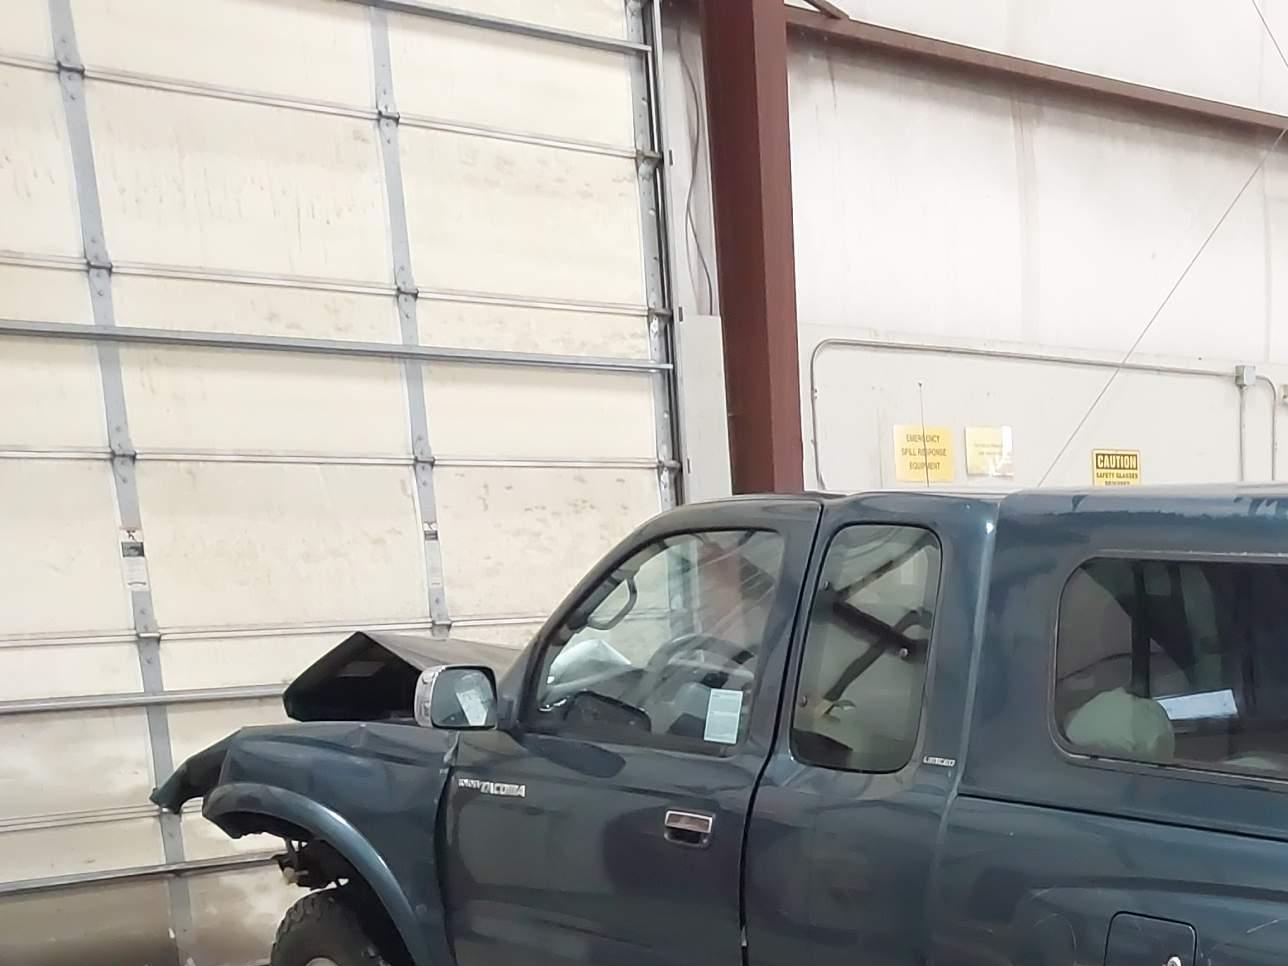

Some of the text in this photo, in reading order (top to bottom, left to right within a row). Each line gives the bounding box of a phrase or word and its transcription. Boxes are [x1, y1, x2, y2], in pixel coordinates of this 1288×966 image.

[901, 447, 917, 456] SPILL
[1097, 454, 1137, 469] CAUTION
[480, 781, 526, 797] TACOMA
